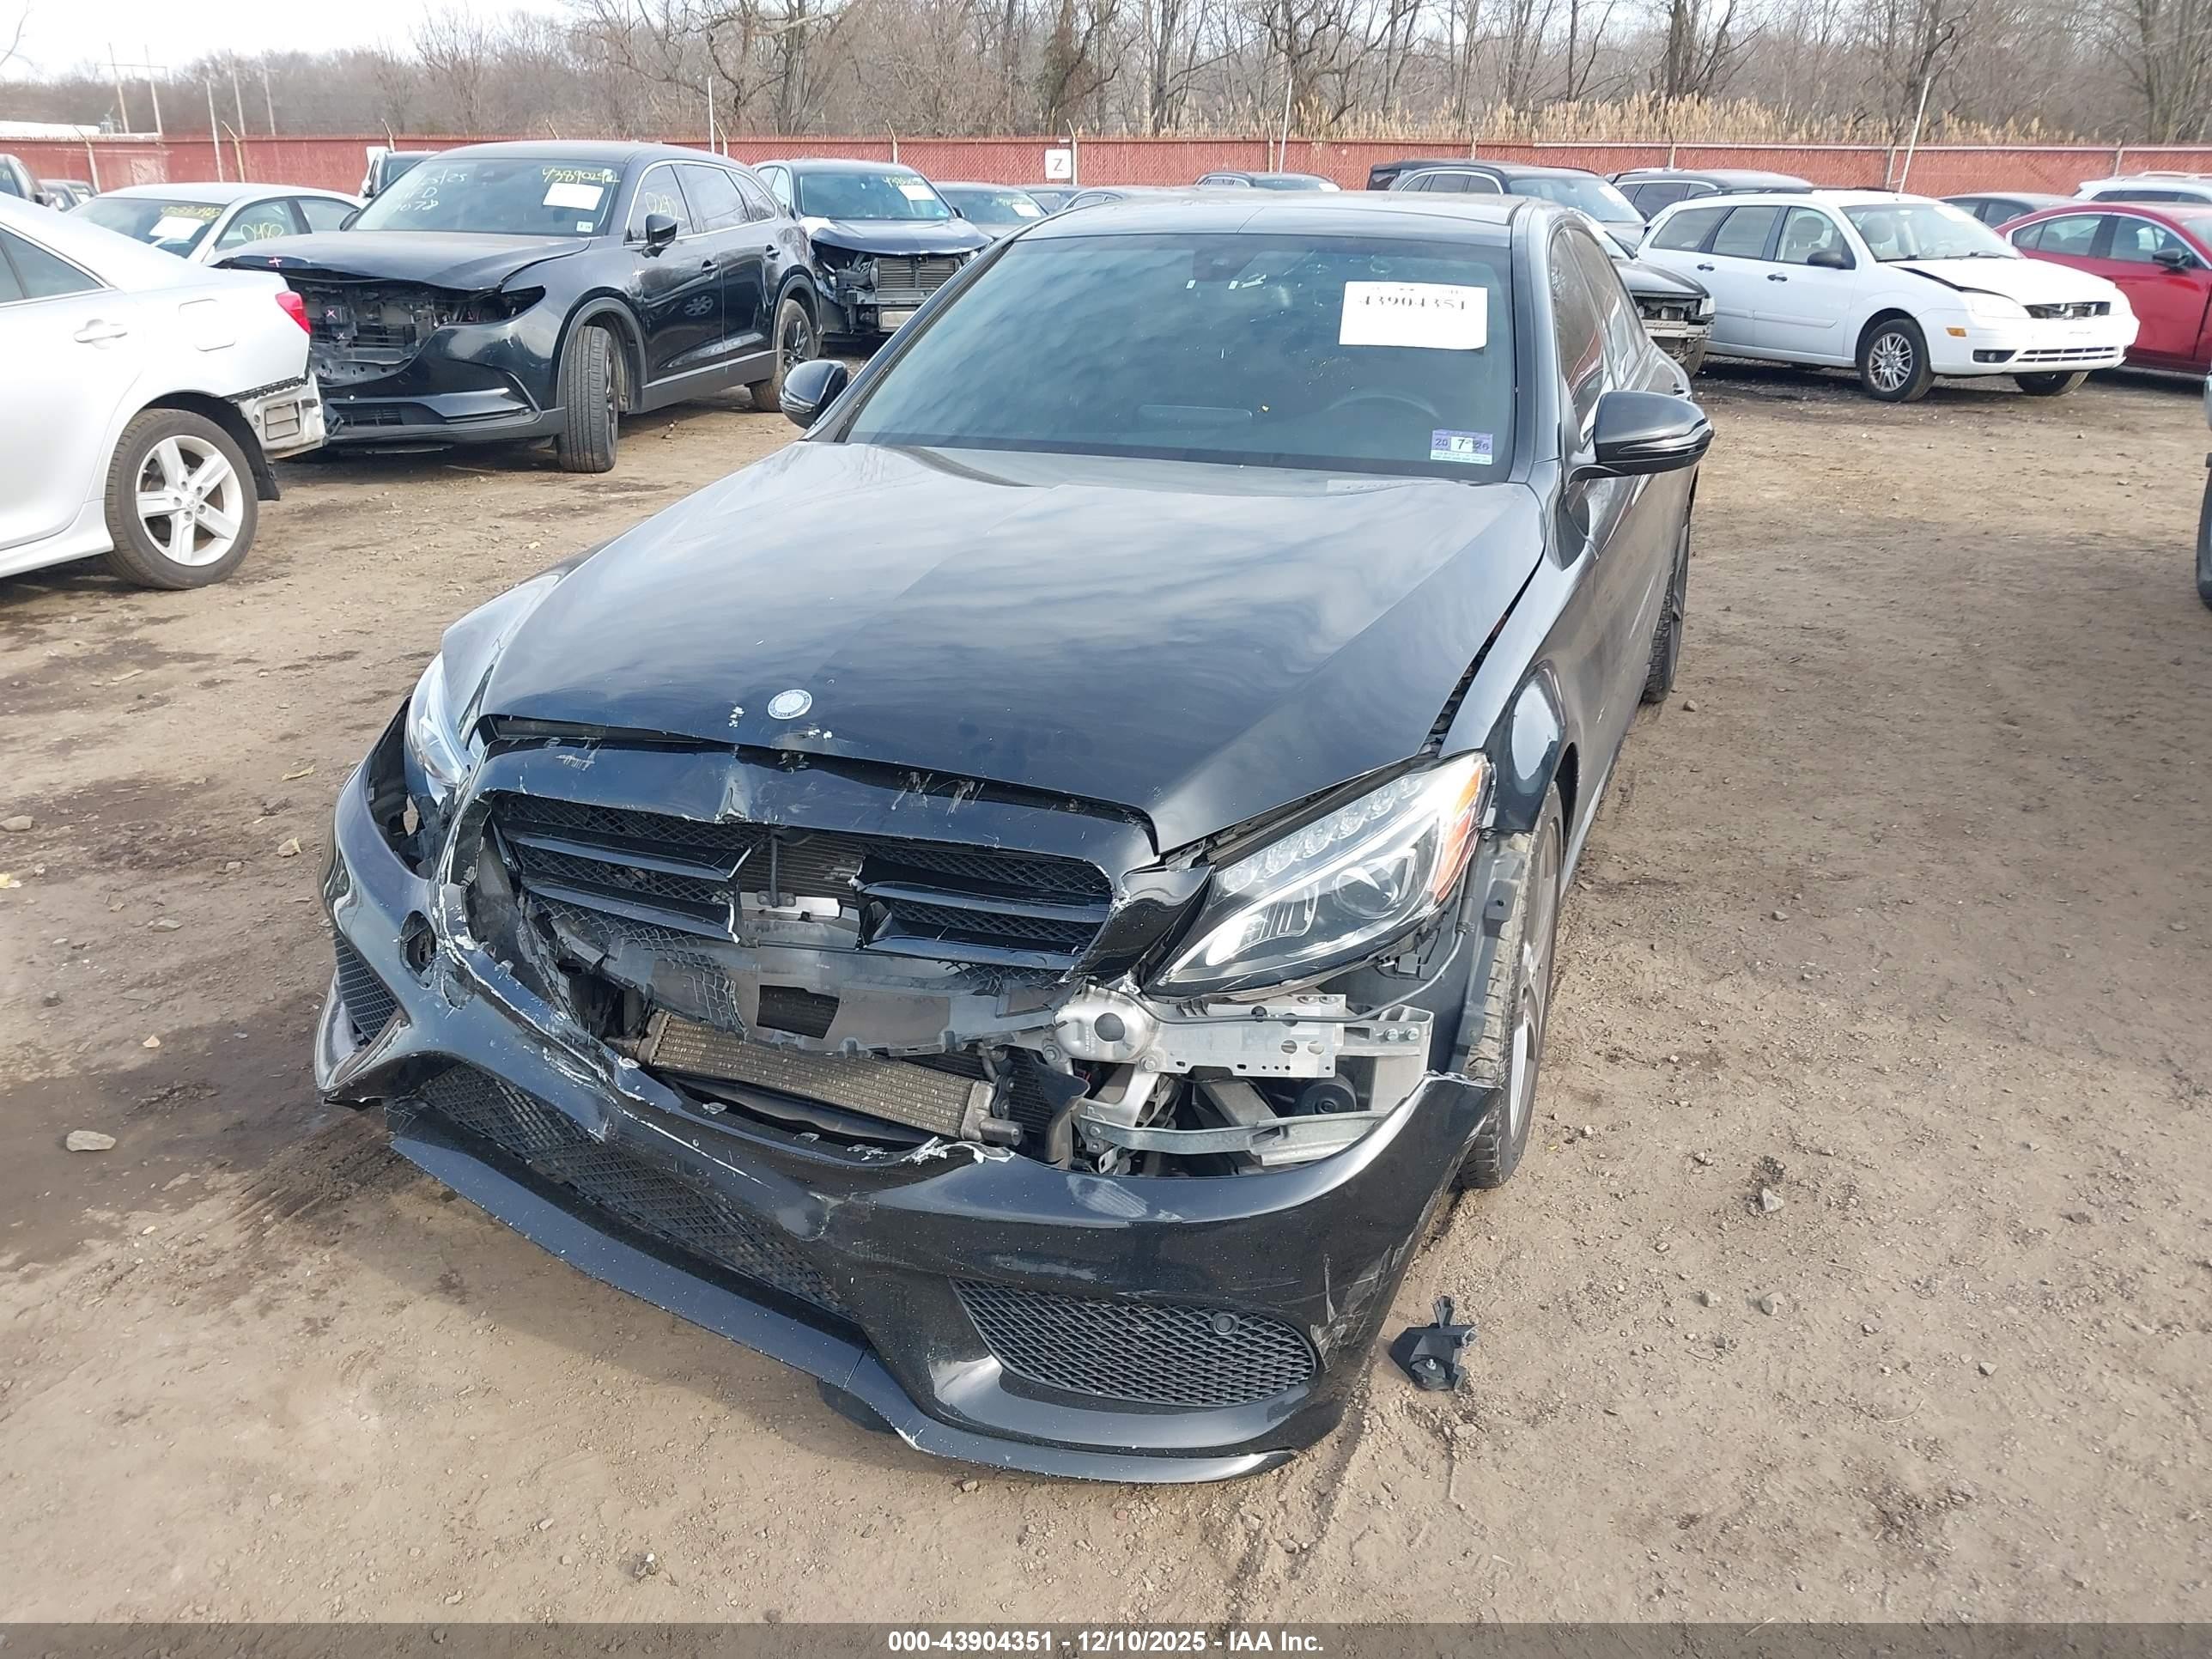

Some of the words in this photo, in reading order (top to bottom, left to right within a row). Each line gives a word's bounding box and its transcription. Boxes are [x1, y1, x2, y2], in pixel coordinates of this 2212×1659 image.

[1053, 158, 1064, 172] Z
[1435, 438, 1449, 447] 20
[1457, 439, 1465, 449] 7
